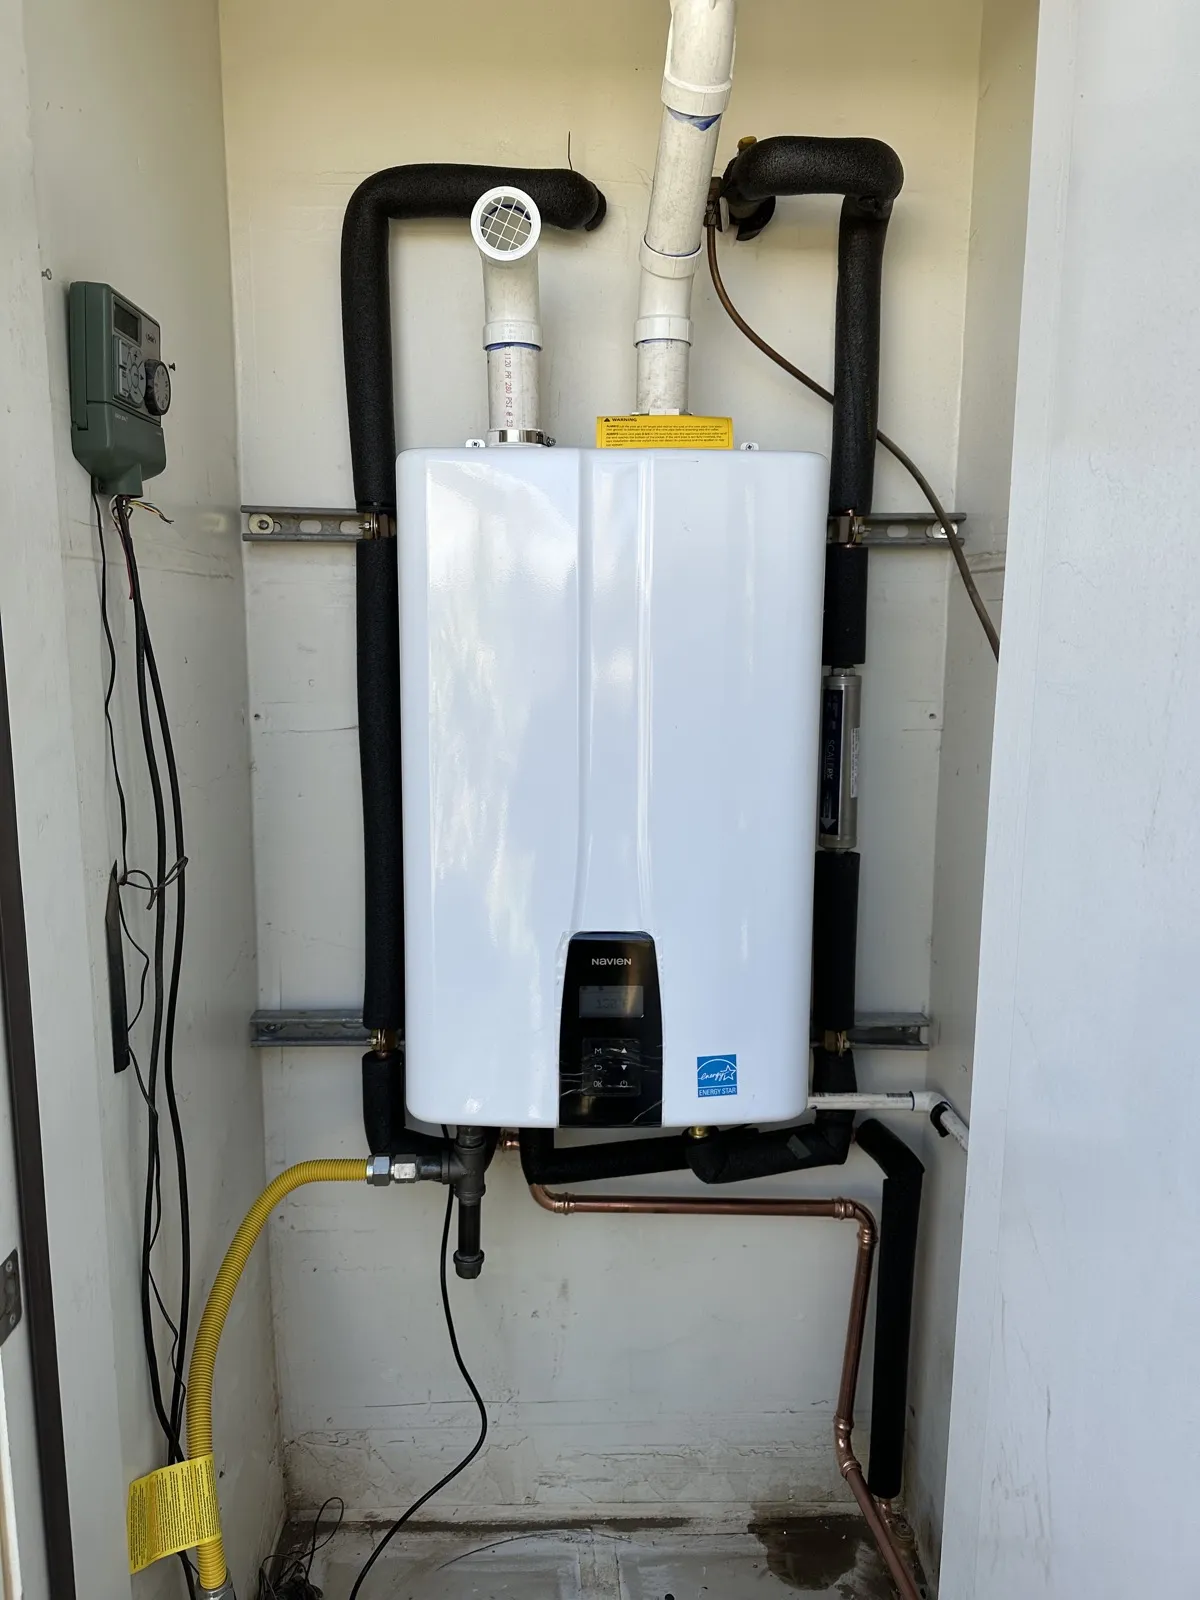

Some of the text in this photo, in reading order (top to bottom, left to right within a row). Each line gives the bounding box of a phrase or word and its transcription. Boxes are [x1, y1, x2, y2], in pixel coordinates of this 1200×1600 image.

[504, 370, 512, 379] PR
[505, 382, 513, 394] 280
[593, 1080, 603, 1088] OK
[698, 1087, 737, 1096] ENERGY STAR
